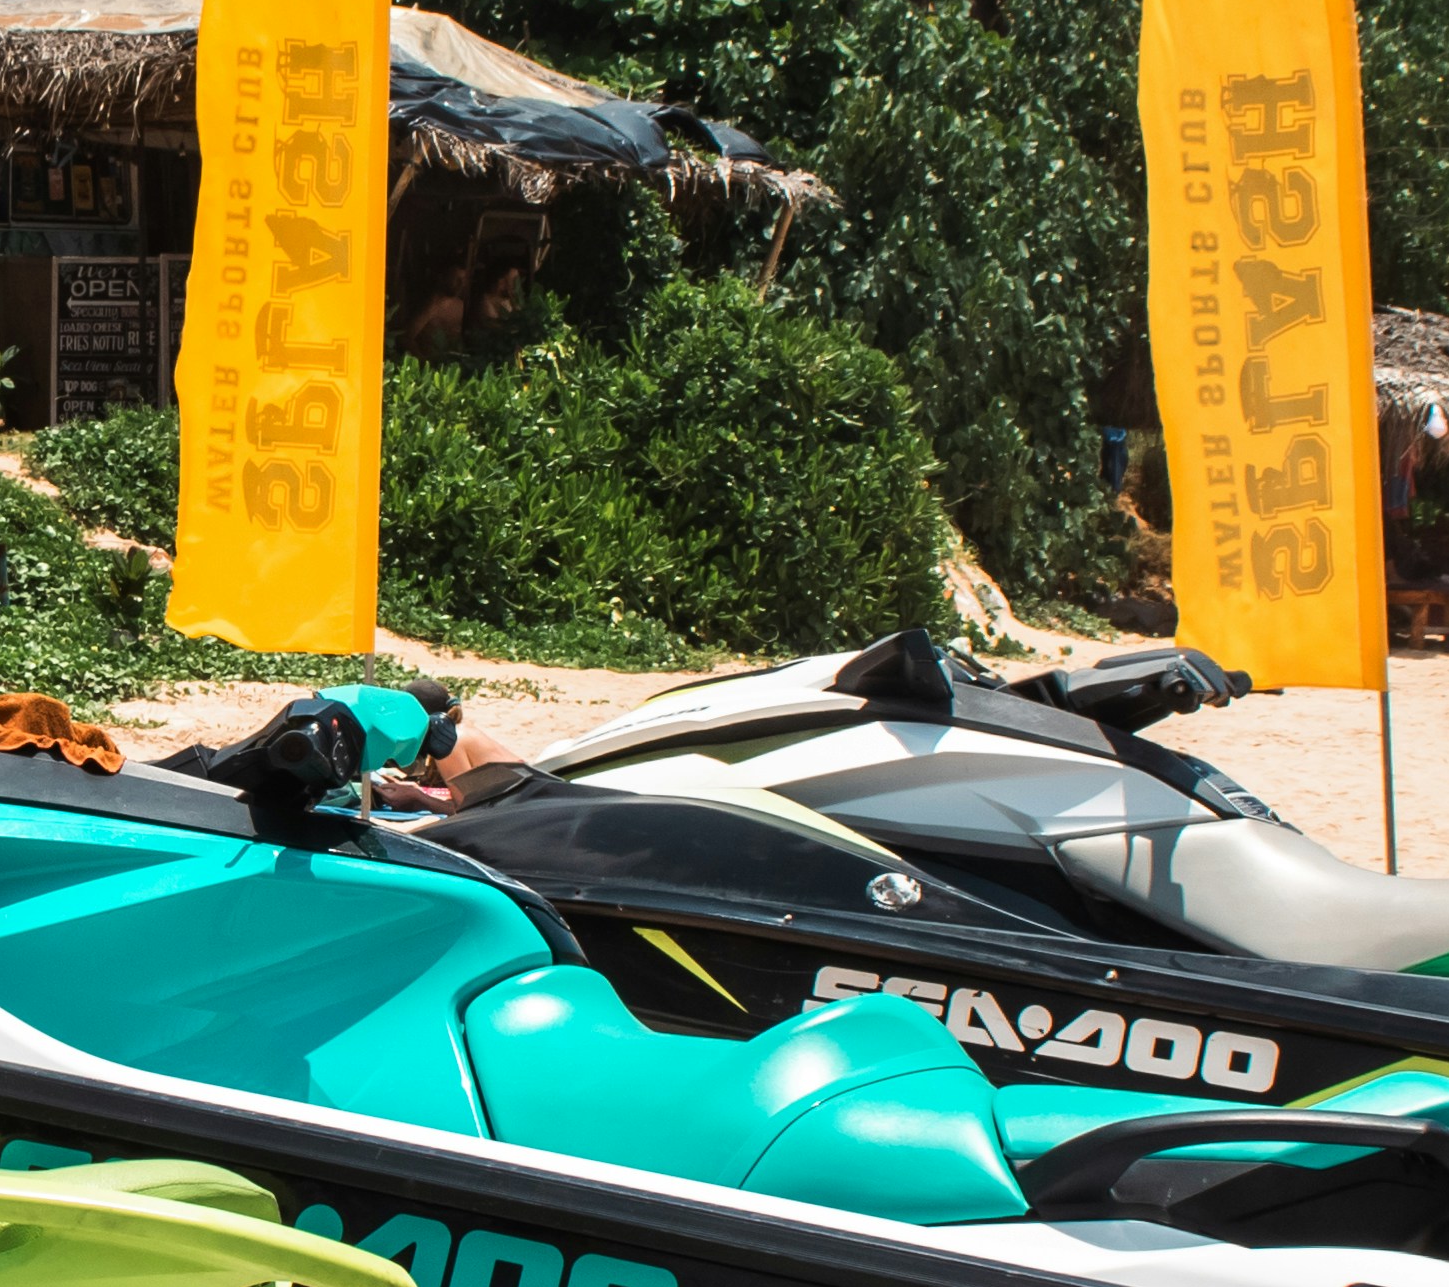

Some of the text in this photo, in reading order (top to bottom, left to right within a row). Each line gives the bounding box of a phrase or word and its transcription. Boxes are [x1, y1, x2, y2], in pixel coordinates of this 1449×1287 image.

[70, 279, 140, 297] OPEN
[59, 335, 89, 352] FRIES
[92, 335, 124, 351] KOTTU
